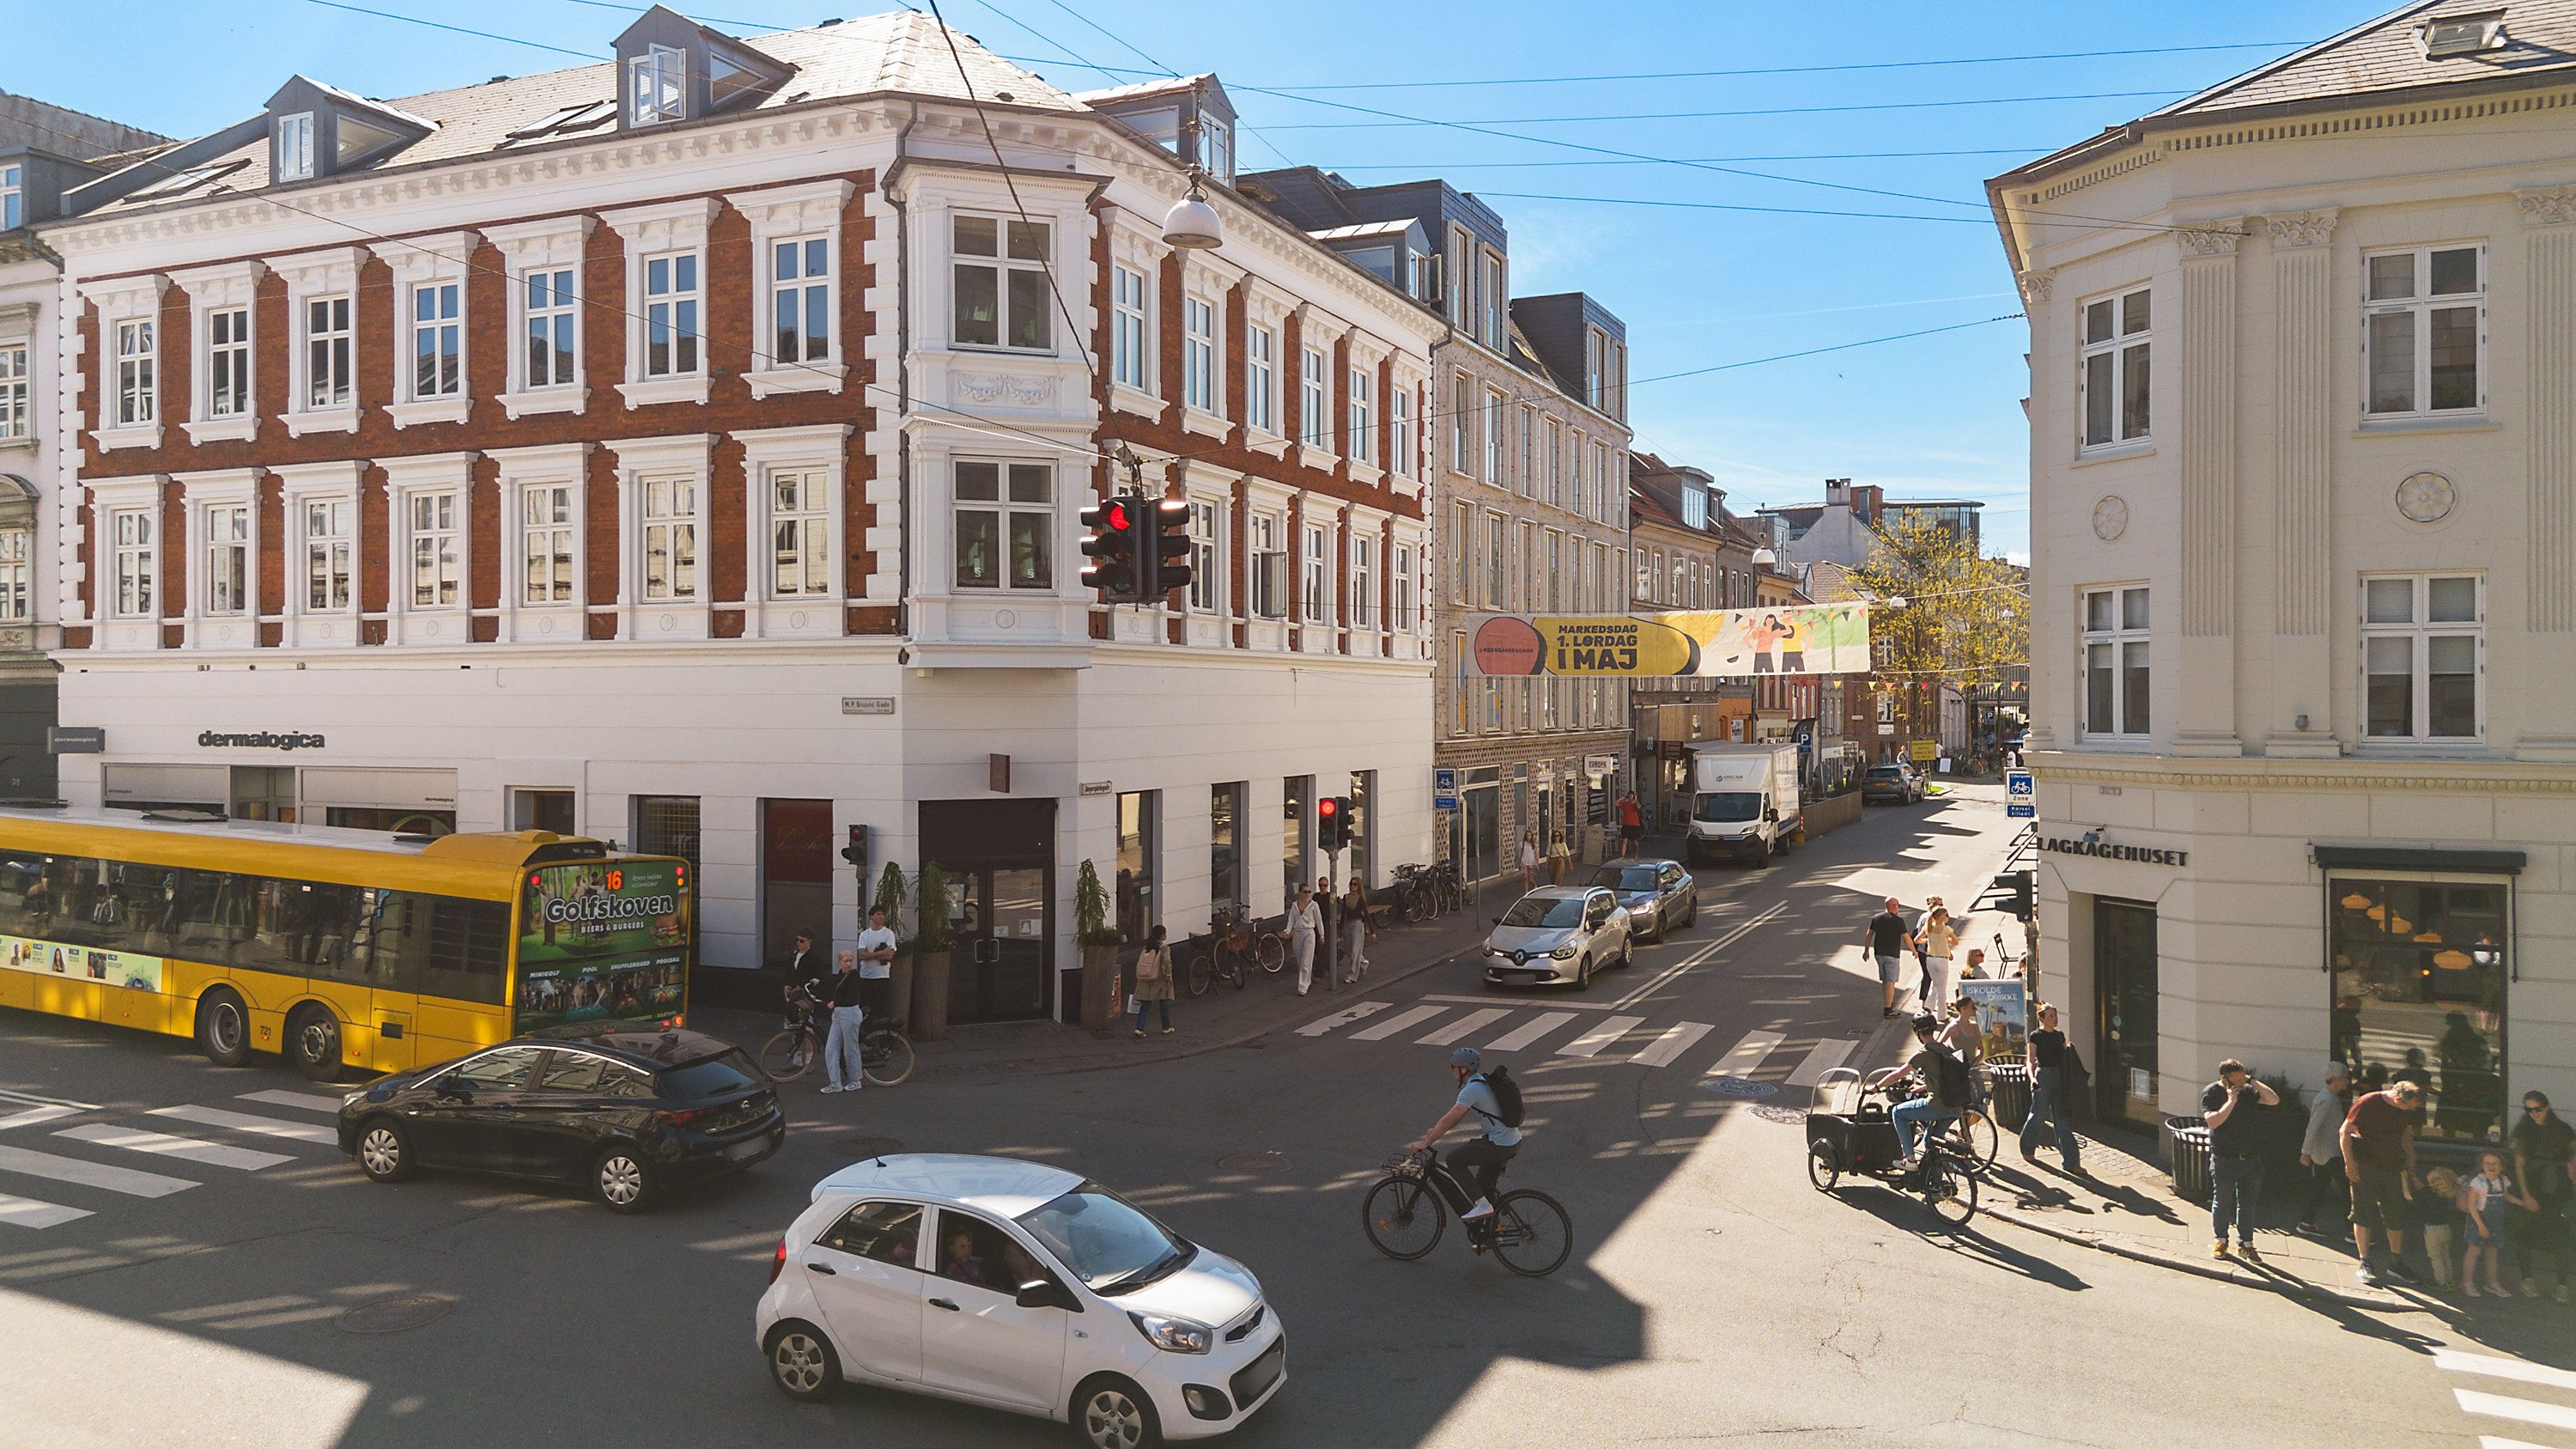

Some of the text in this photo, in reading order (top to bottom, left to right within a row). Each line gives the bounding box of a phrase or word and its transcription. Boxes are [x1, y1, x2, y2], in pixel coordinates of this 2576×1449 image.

[1558, 624, 1637, 634] MARKEDSDAG
[1557, 635, 1637, 647] 1. LØRDAG
[1558, 648, 1637, 670] I MAJ
[198, 730, 325, 751] dermalogica
[1801, 734, 1809, 745] P
[2037, 837, 2189, 867] LAGKAGEHUSET
[605, 869, 623, 892] 16
[546, 894, 672, 922] Golfskoven
[581, 924, 604, 934] BEERS
[613, 921, 644, 930] BURGERS
[530, 970, 560, 978] MINIGOLF
[611, 960, 651, 971] SHUFFLEBOARD
